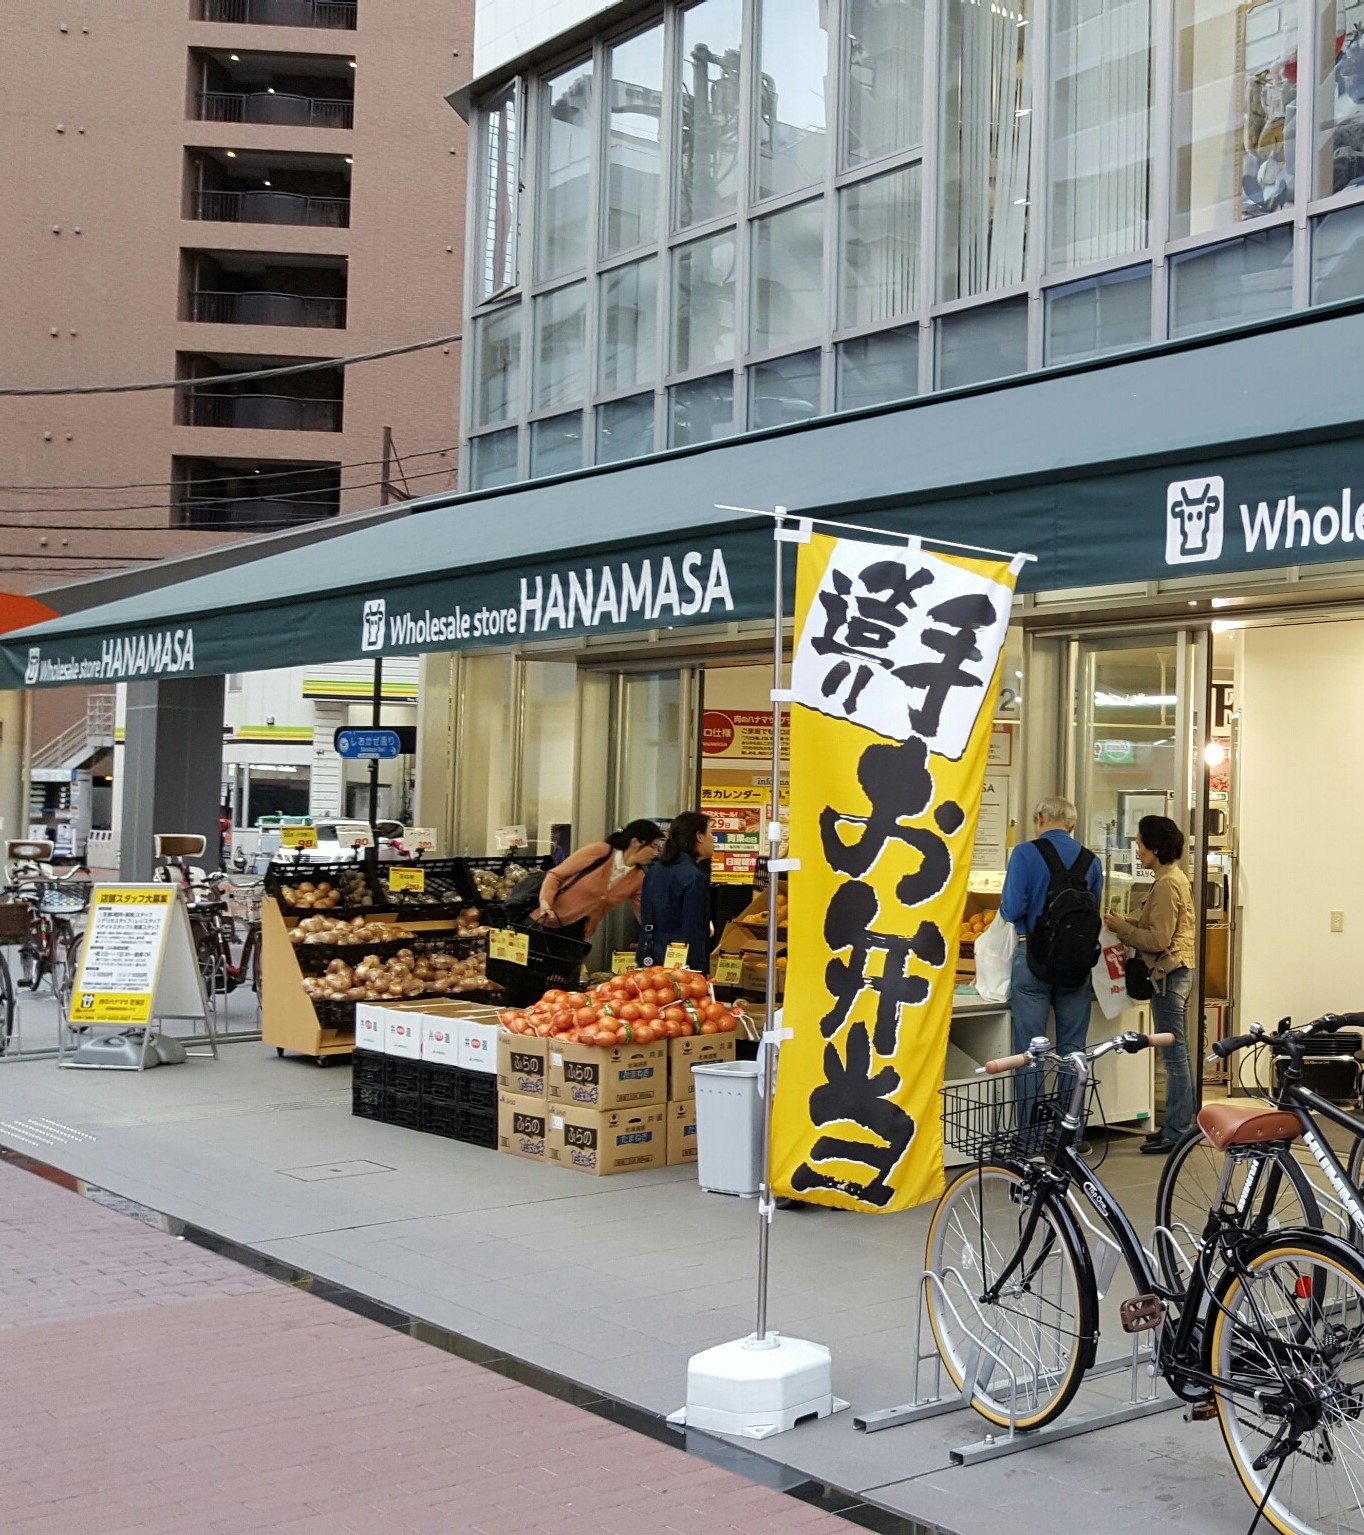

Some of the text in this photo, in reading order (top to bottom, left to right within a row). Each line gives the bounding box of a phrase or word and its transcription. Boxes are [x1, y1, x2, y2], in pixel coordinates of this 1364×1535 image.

[389, 548, 734, 646] Wholesale store HANAMASA
[39, 628, 194, 682] Wholesale store HANAMASA
[791, 735, 964, 1208] お弁当
[514, 1055, 539, 1073] ふらの
[568, 1063, 594, 1081] ふらの
[516, 1115, 540, 1134] ふらの
[568, 1127, 593, 1146] ふらの
[1236, 1158, 1260, 1213] HUMME
[1088, 1187, 1107, 1209] Top One
